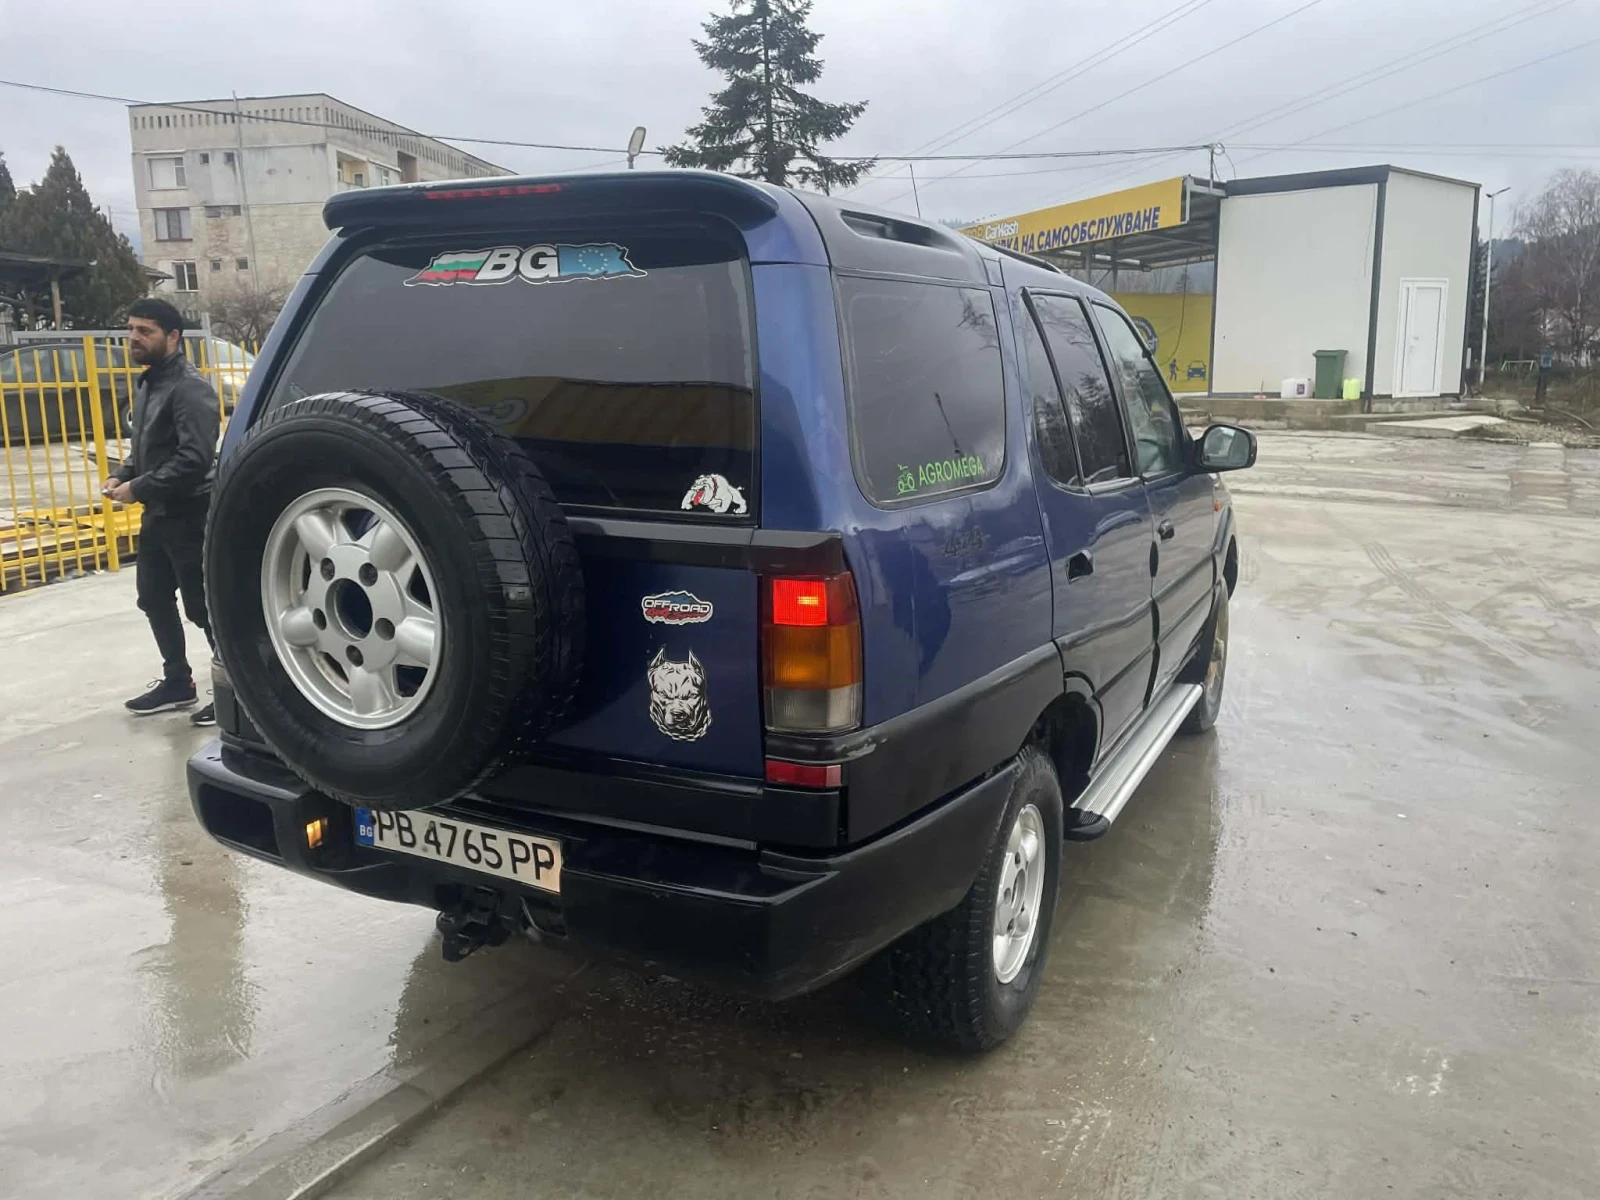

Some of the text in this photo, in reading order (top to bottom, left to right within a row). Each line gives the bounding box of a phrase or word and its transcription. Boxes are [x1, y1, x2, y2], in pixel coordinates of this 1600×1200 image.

[1021, 232, 1035, 254] НА
[1037, 206, 1161, 250] САМООБСЛУЖВАНЕ
[474, 246, 560, 281] BG
[918, 456, 985, 487] AGROMEGA
[359, 824, 373, 837] BG
